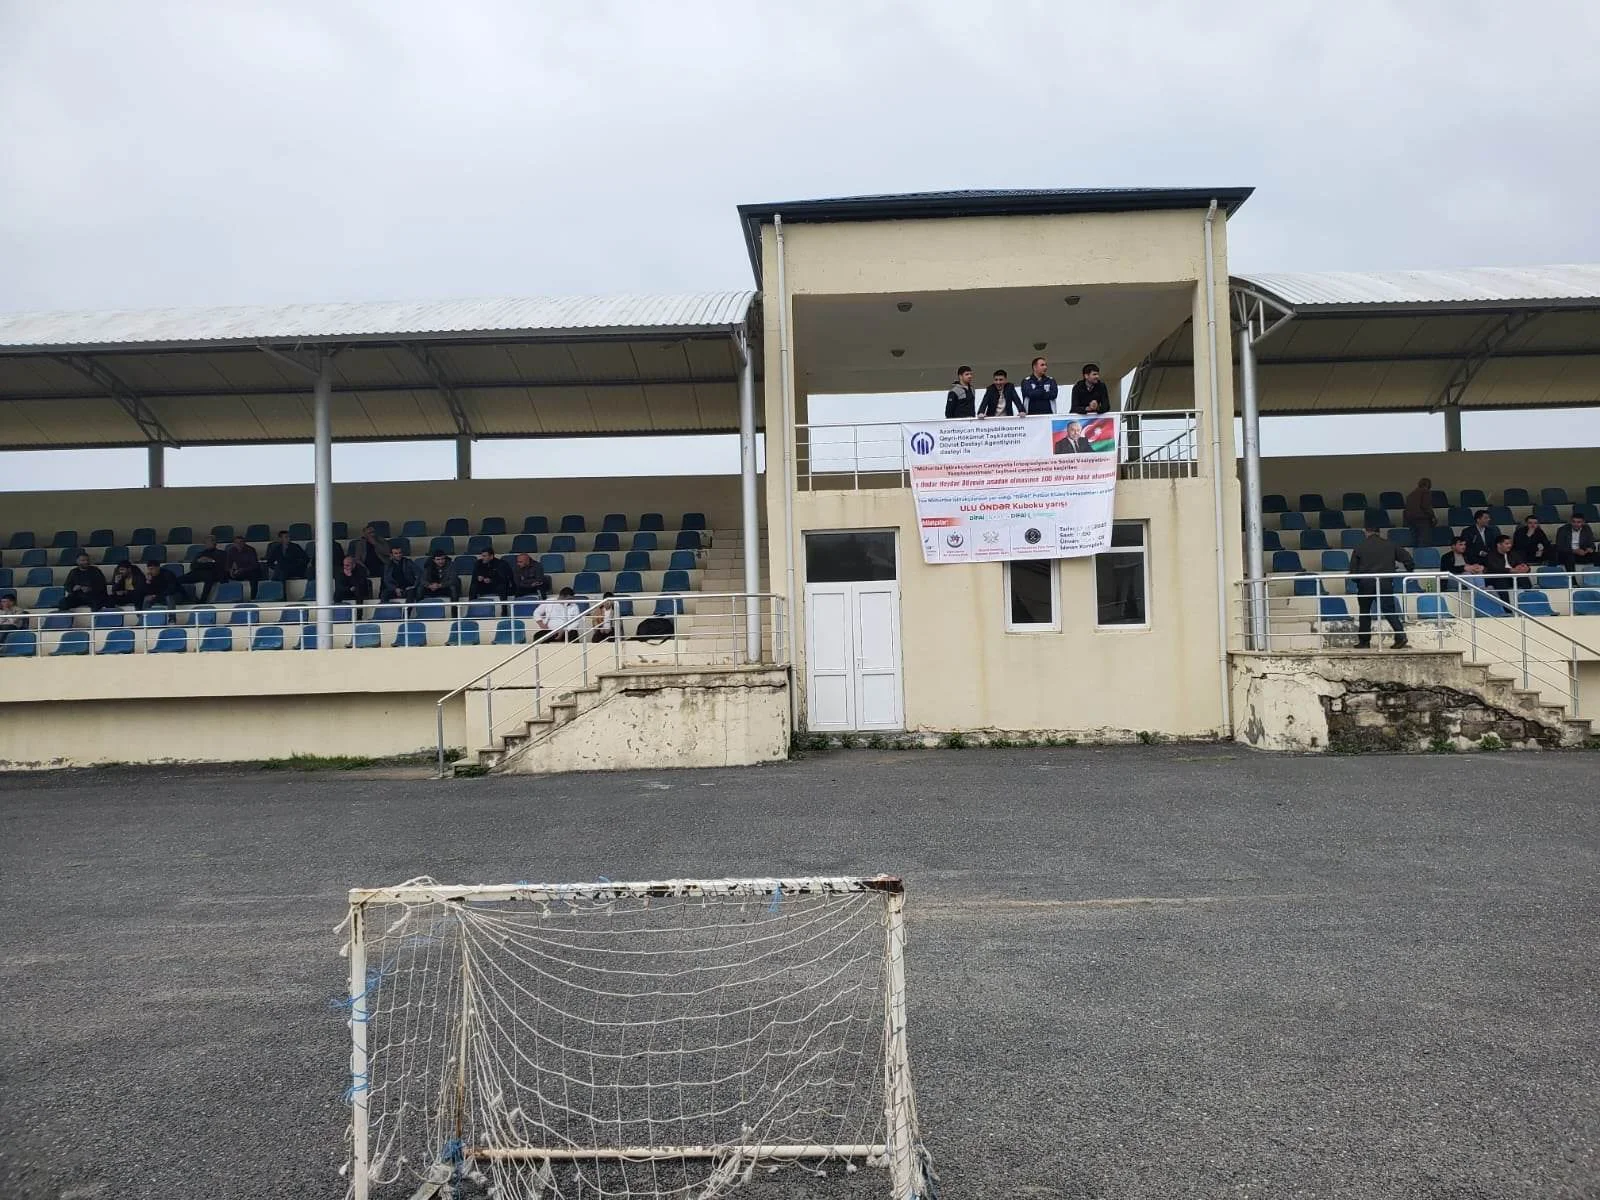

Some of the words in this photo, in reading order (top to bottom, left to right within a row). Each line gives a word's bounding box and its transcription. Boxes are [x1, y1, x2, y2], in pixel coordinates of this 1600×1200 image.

[960, 504, 977, 512] ULU
[979, 502, 1010, 511] ÖNDƏR
[1012, 502, 1044, 510] Kuboku
[1046, 501, 1068, 509] yarışı
